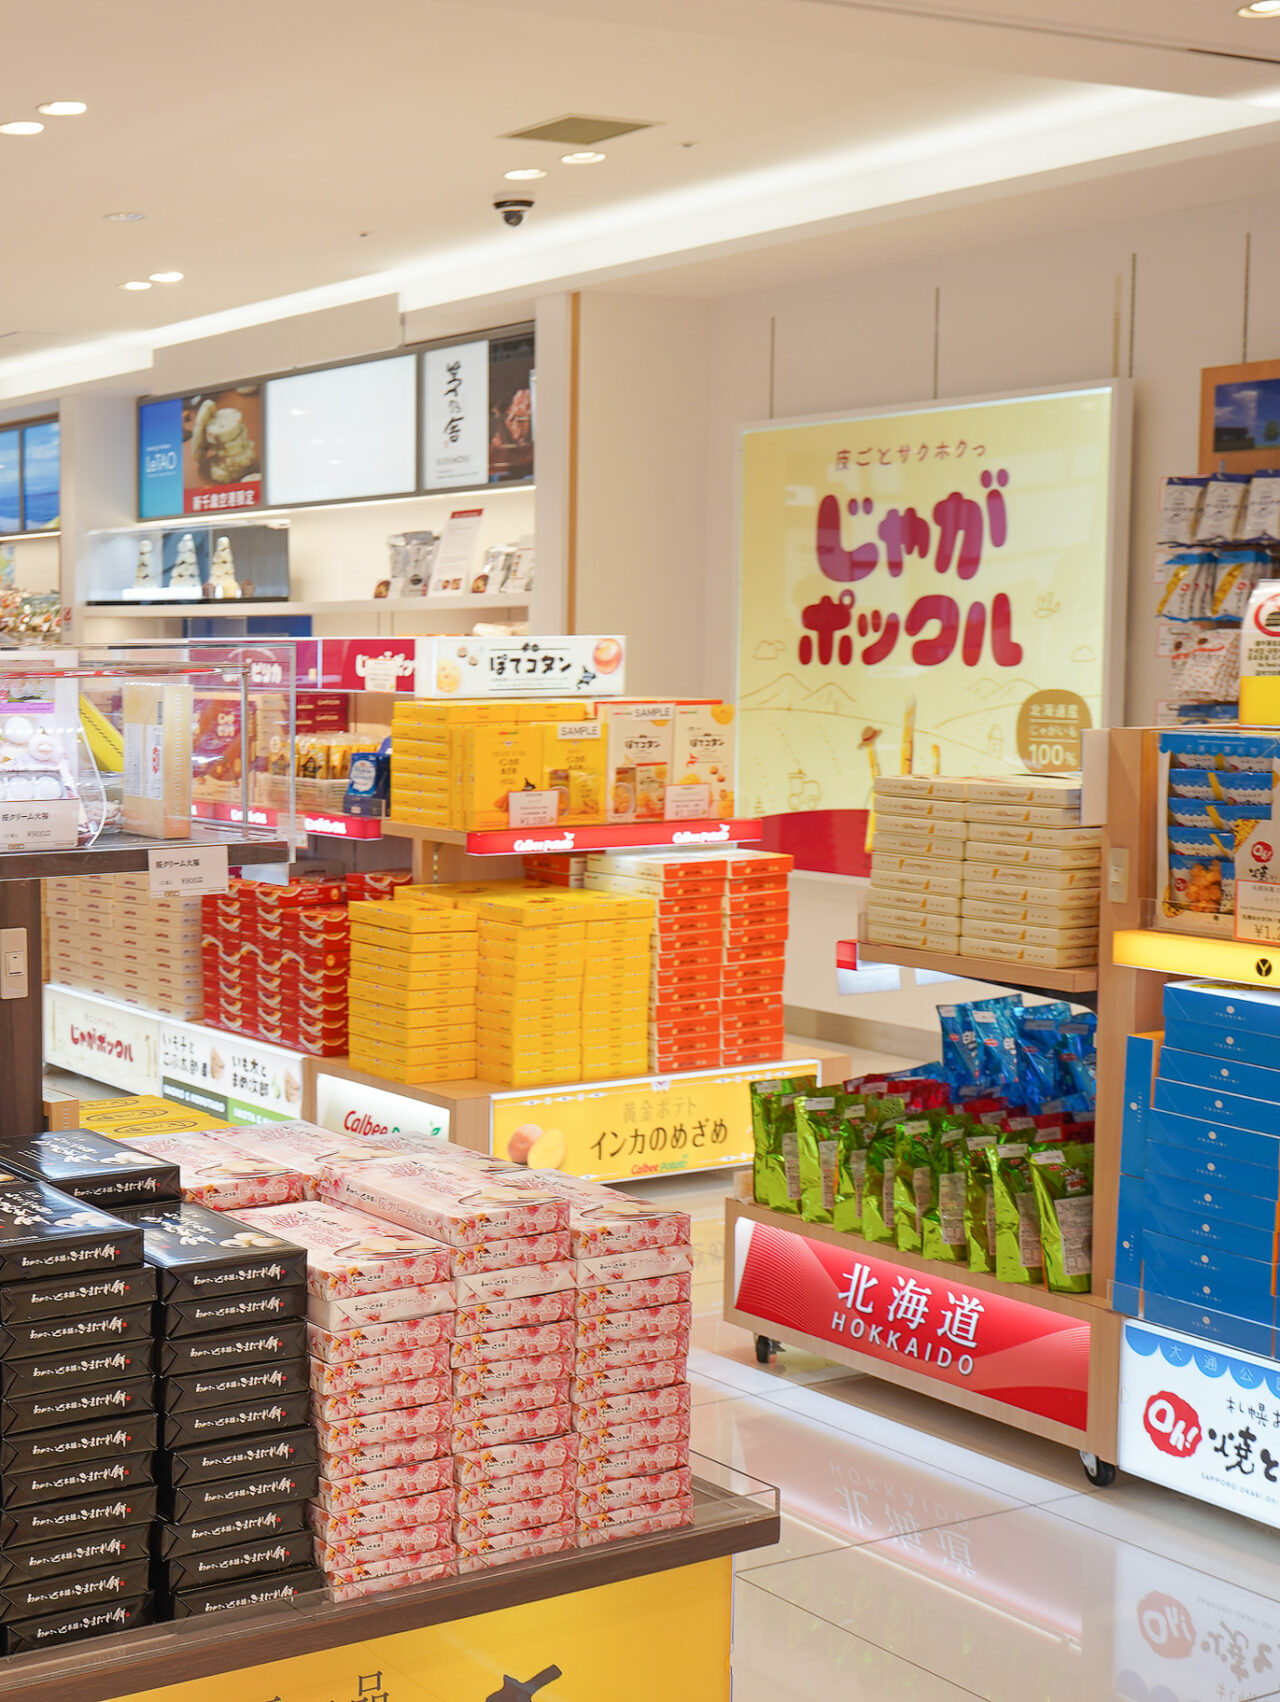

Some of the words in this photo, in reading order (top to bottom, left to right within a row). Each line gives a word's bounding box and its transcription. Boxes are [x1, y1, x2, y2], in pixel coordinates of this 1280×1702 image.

[835, 439, 987, 471] 皮ごとサクホクっ
[816, 469, 1009, 582] じゃが
[798, 589, 1023, 667] ポックル
[560, 726, 599, 737] SAMPLE
[634, 708, 671, 718] SAMPLE
[1028, 744, 1077, 766] 100%
[590, 1118, 728, 1162] インカのめざめ
[838, 1262, 984, 1348] 北海道
[831, 1311, 974, 1375] HOKKAIDO
[1148, 1399, 1199, 1451] Oh!
[1201, 1472, 1238, 1492] SAPPORO
[1239, 1485, 1263, 1500] OKAKI
